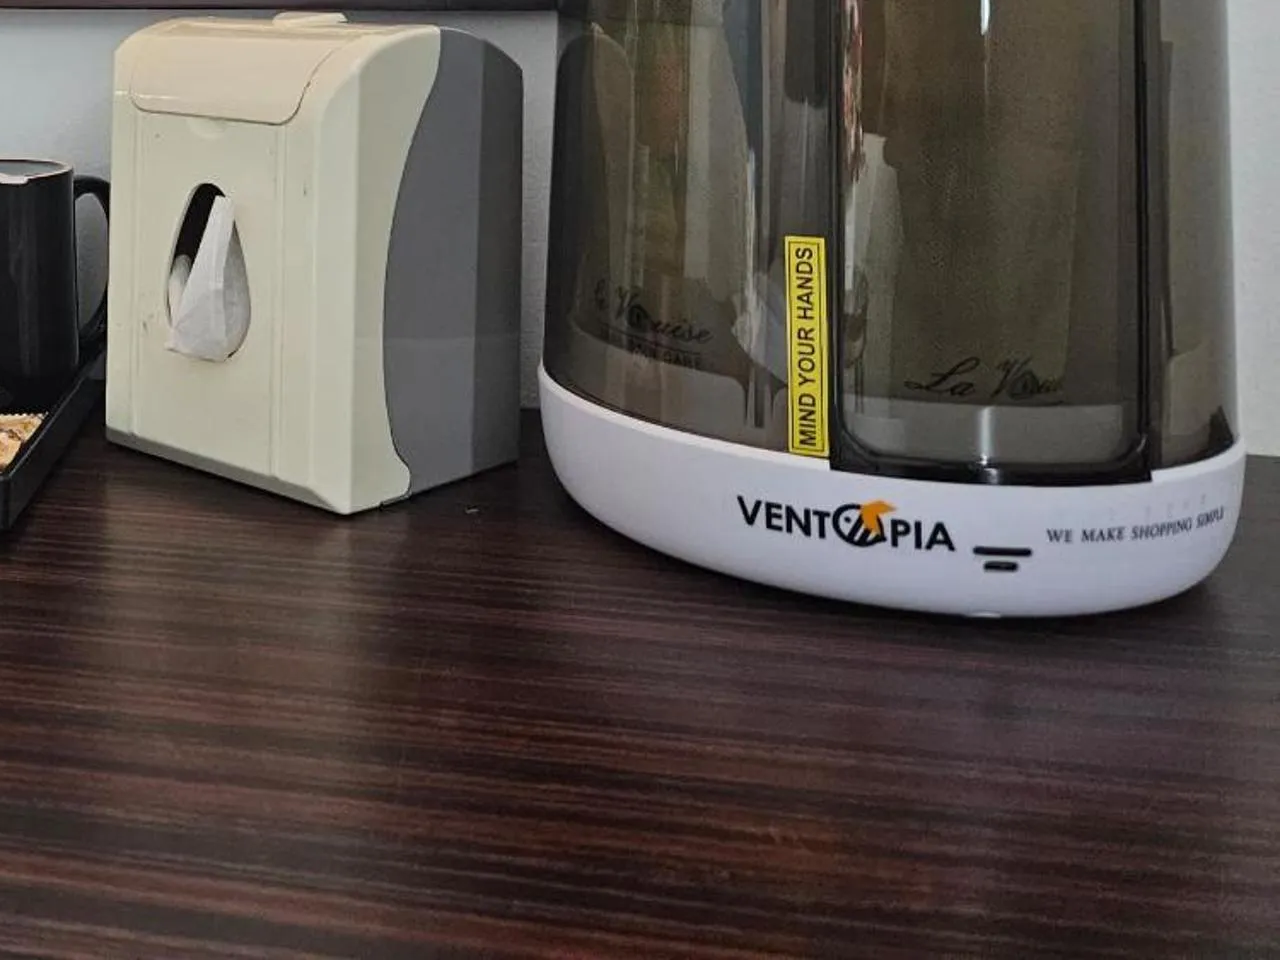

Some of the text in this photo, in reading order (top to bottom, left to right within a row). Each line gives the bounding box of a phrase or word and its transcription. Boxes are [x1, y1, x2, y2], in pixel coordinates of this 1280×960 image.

[795, 247, 818, 448] MIND YOUR HANDS
[737, 495, 956, 553] VENTOPIA
[1046, 528, 1073, 543] WE
[1081, 526, 1126, 542] MAKE
[1131, 517, 1194, 540] SHOPPING
